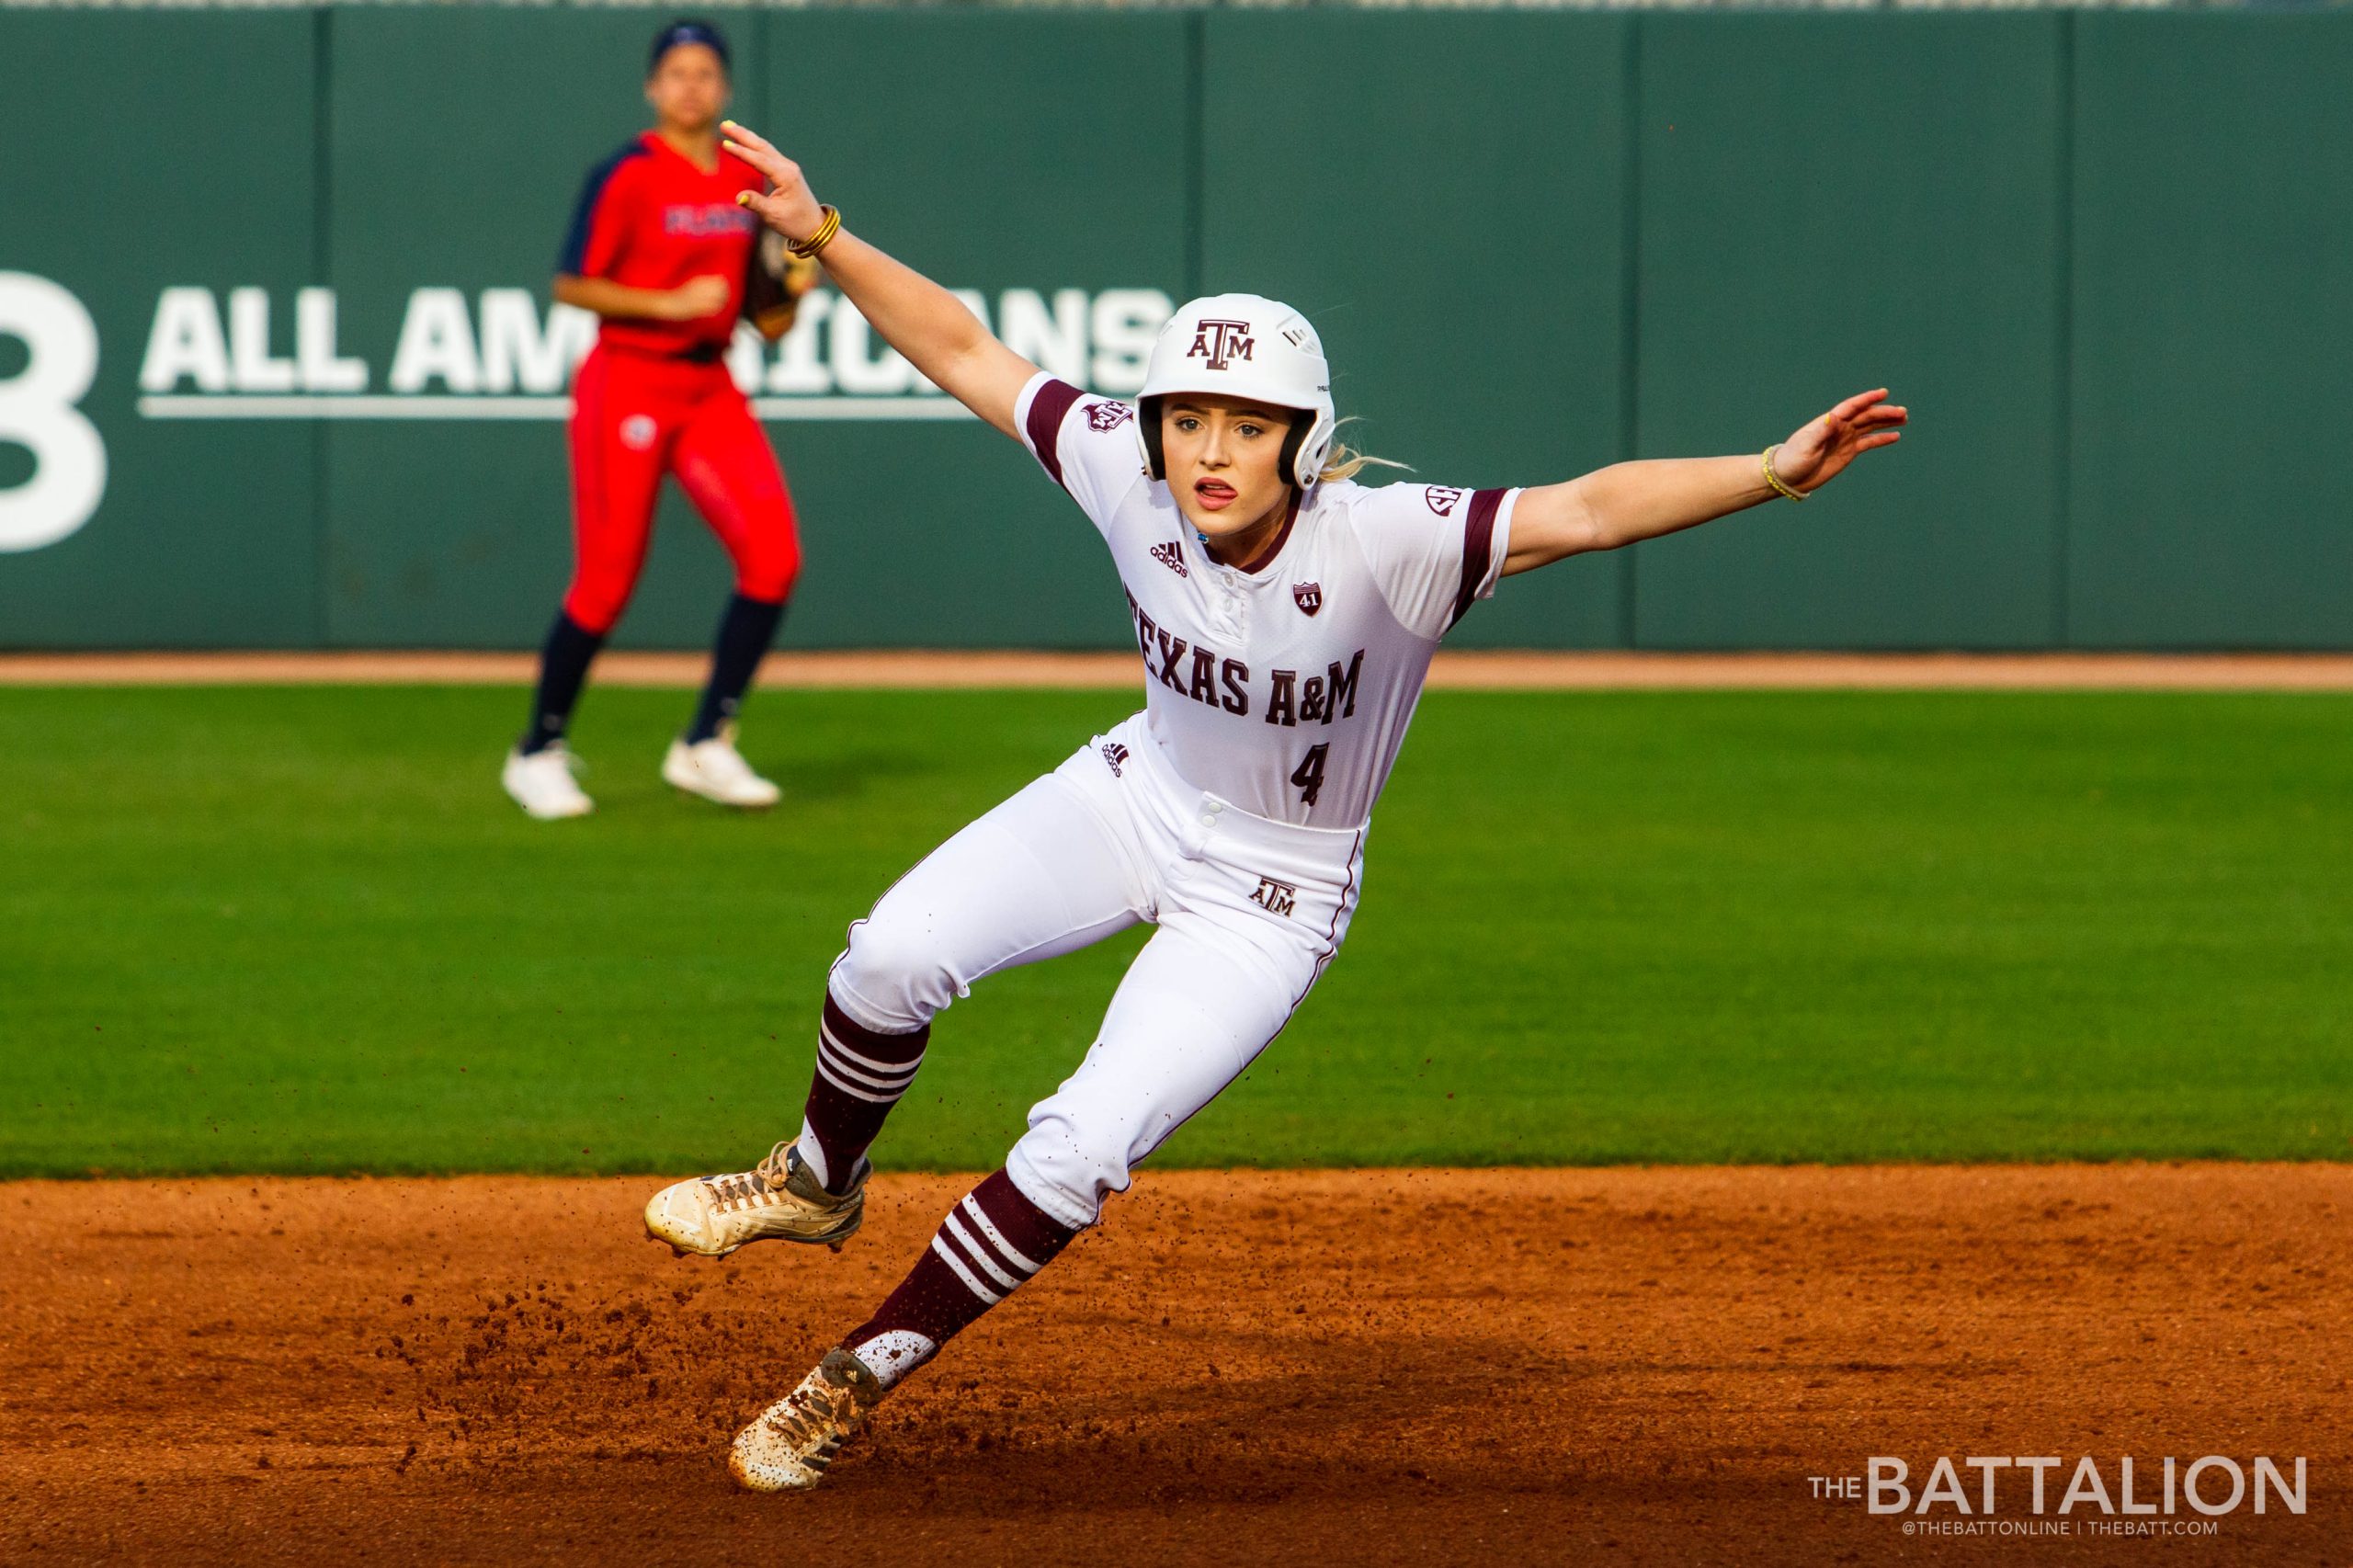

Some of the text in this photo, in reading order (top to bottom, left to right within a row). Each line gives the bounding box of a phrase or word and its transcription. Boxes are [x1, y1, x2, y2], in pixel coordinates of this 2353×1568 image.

[138, 287, 1175, 395] ALL AMICNS
[1150, 546, 1188, 579] adidas
[1299, 593, 1319, 608] 41
[1265, 648, 1365, 727] A&M
[1102, 744, 1122, 778] adidas
[1290, 742, 1330, 807] 4
